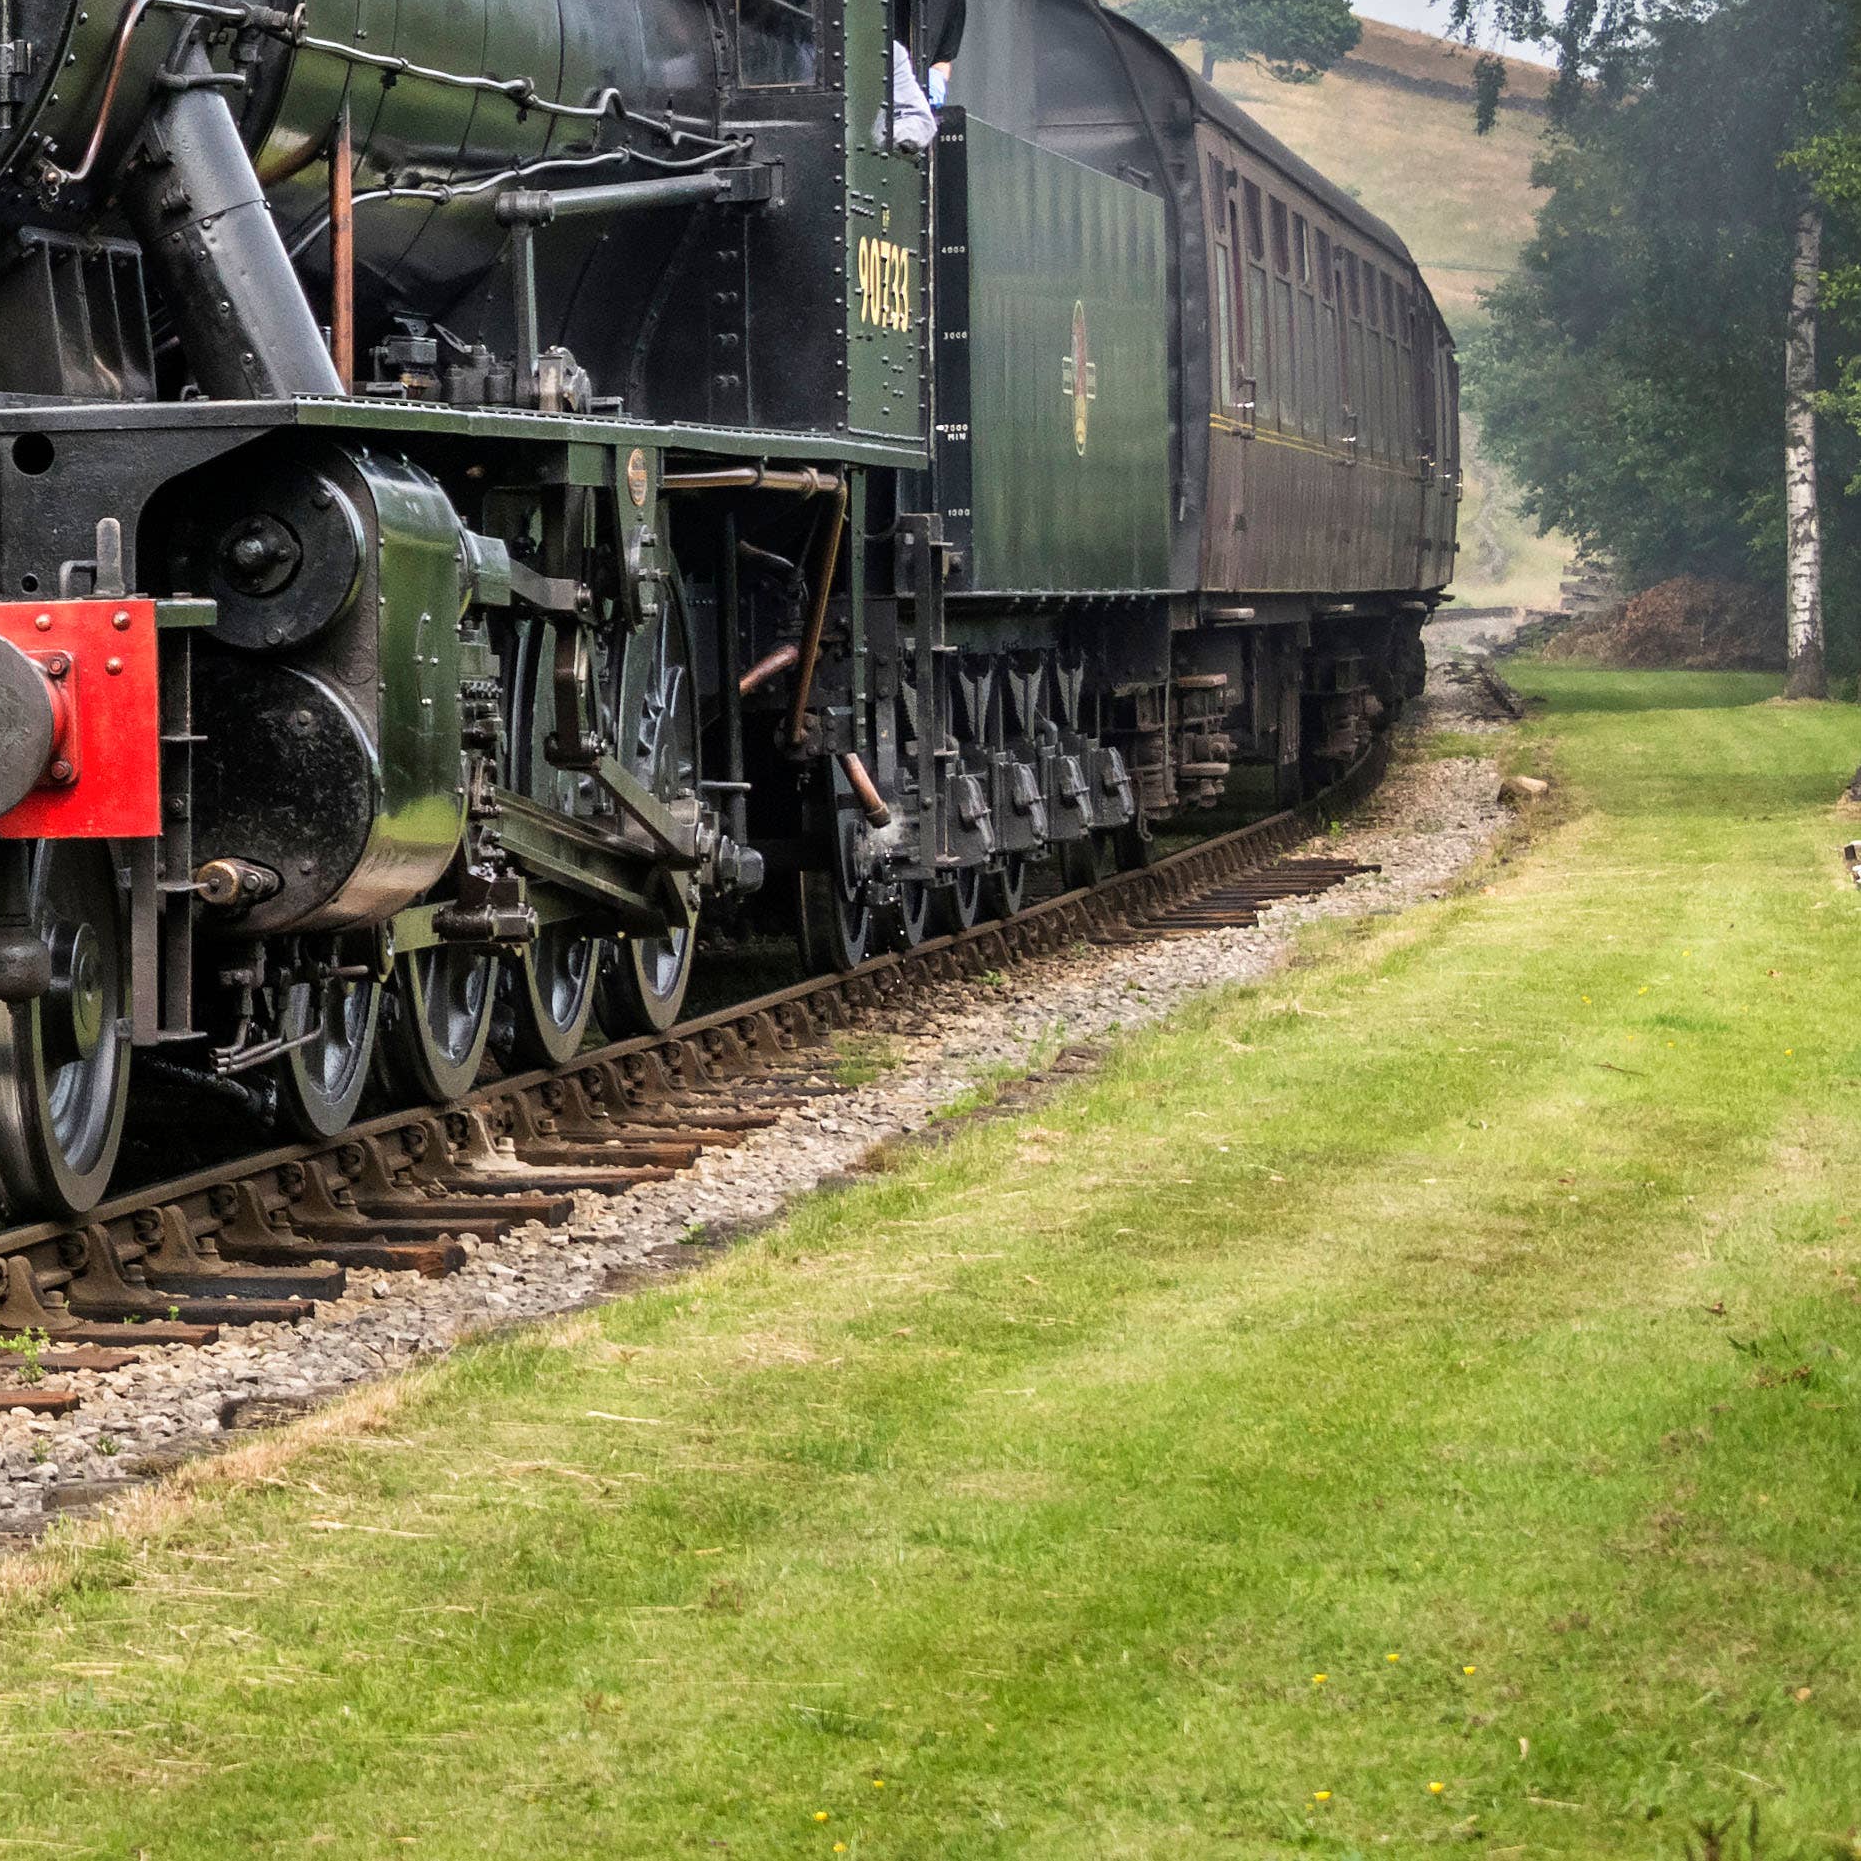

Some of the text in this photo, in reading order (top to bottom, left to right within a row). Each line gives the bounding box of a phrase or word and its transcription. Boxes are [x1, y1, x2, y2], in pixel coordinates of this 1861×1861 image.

[941, 245, 966, 254] 4000
[858, 236, 909, 333] 90733
[943, 331, 968, 340] 3000
[943, 424, 969, 433] 2000
[947, 433, 967, 441] MIN
[948, 508, 970, 517] 1000
